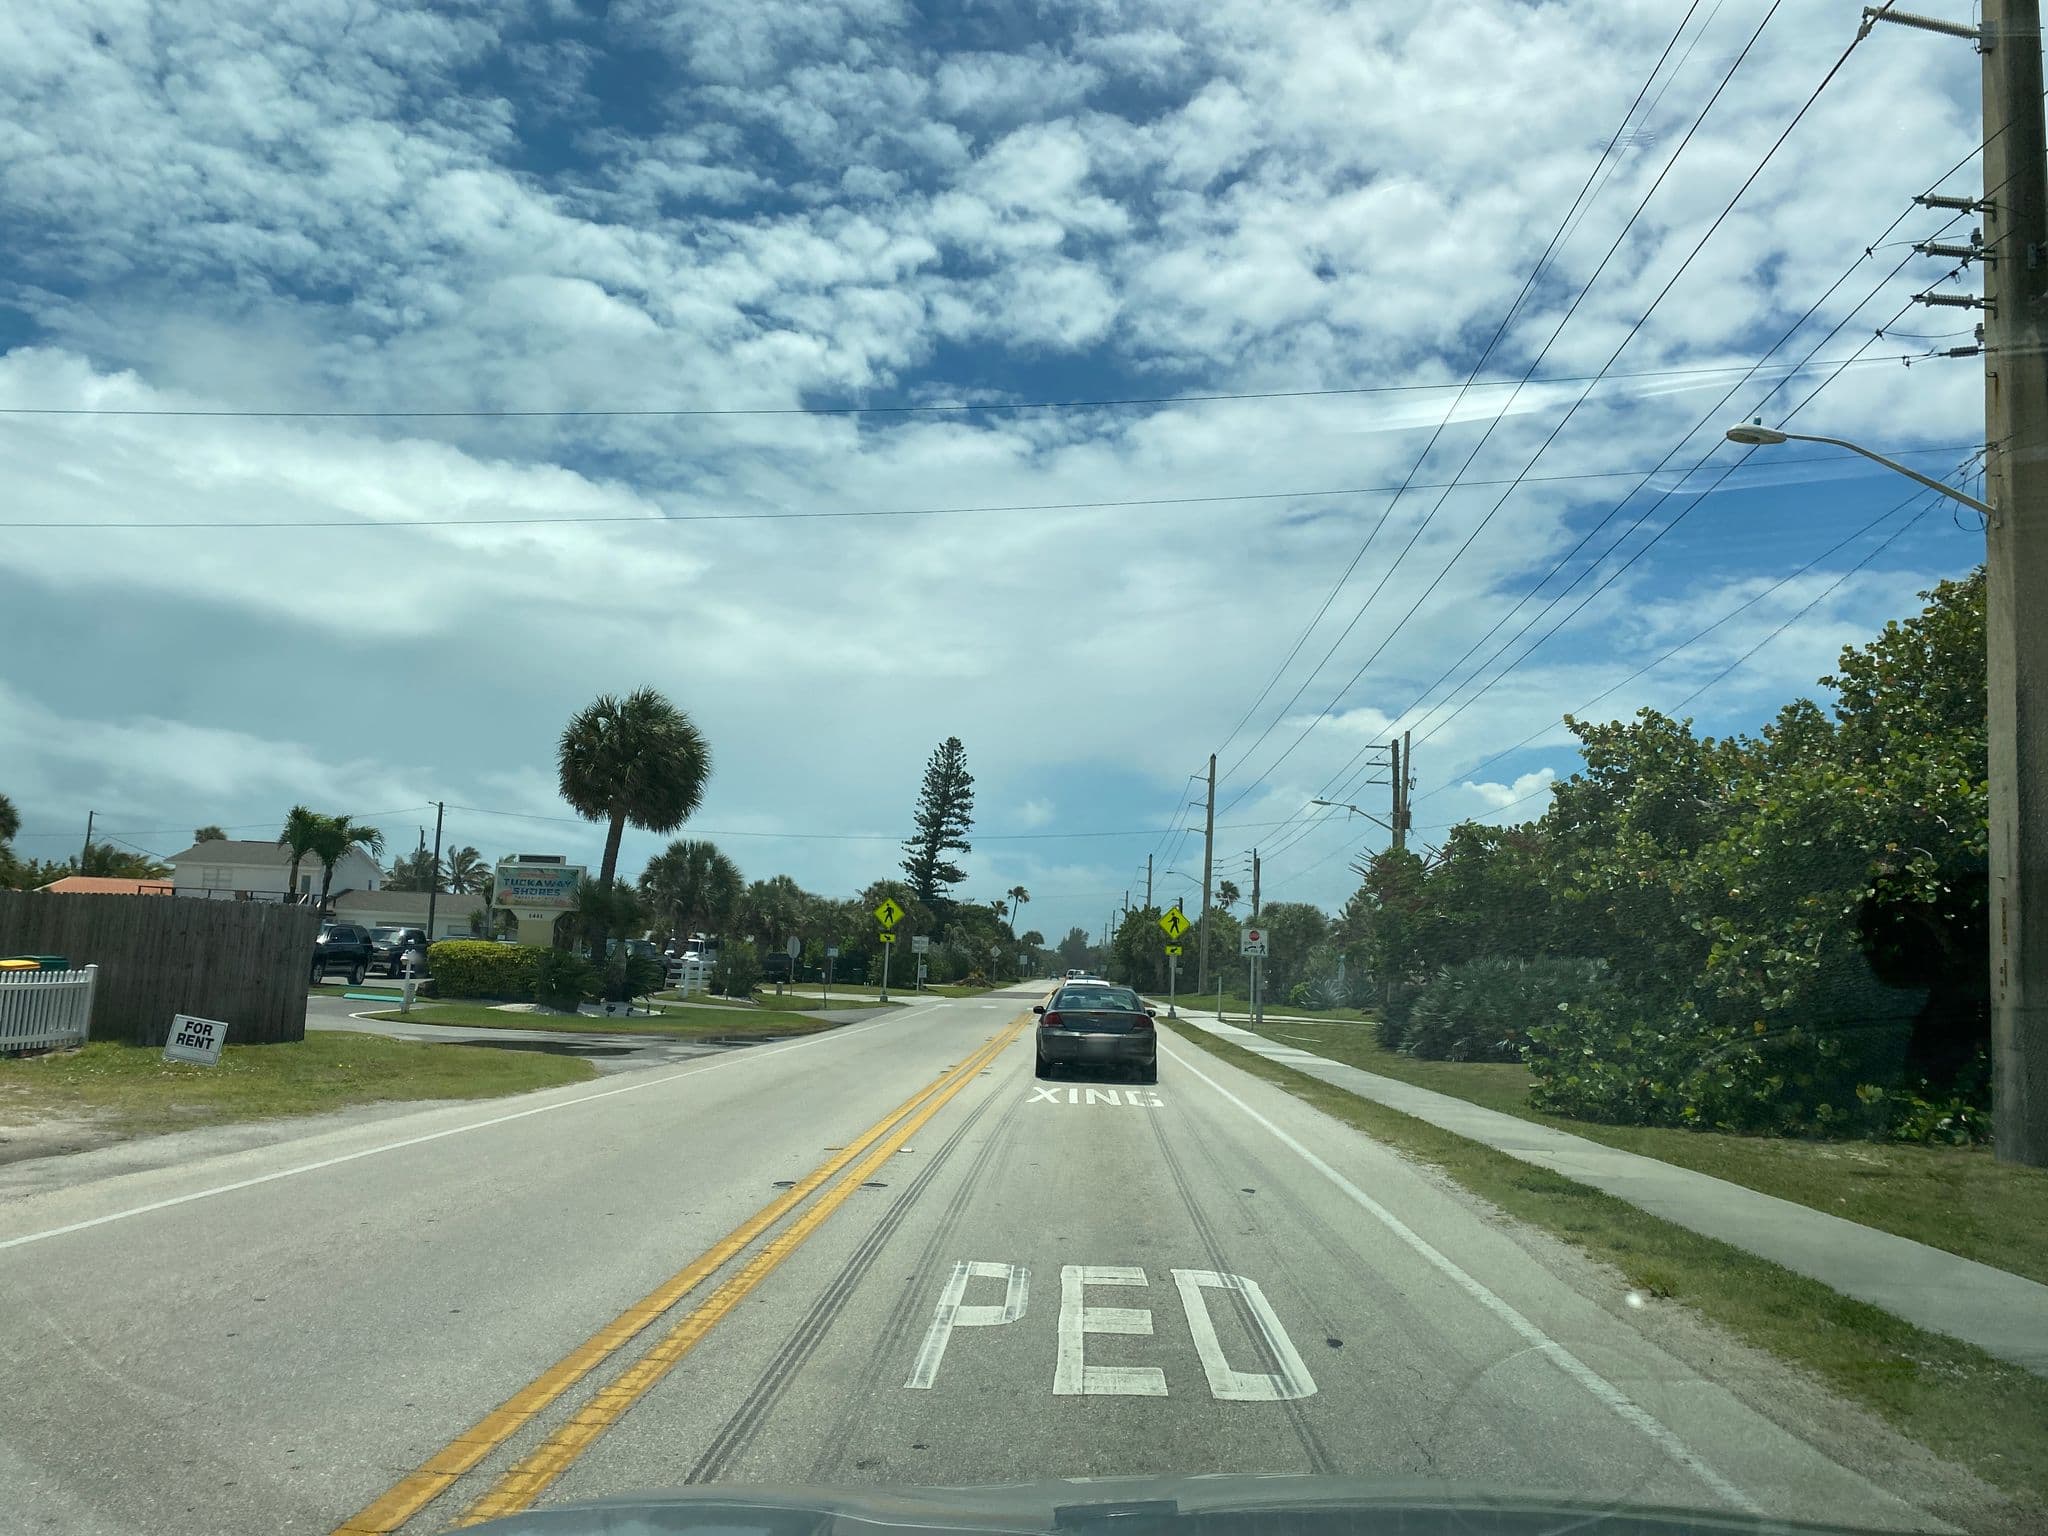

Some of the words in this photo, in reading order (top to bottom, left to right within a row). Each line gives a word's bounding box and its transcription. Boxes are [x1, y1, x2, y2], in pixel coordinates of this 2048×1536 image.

[512, 887, 560, 896] SHORES
[184, 1021, 213, 1036] FOR
[176, 1033, 214, 1049] RENT
[1025, 1086, 1164, 1107] XING
[903, 1260, 1318, 1401] PED
